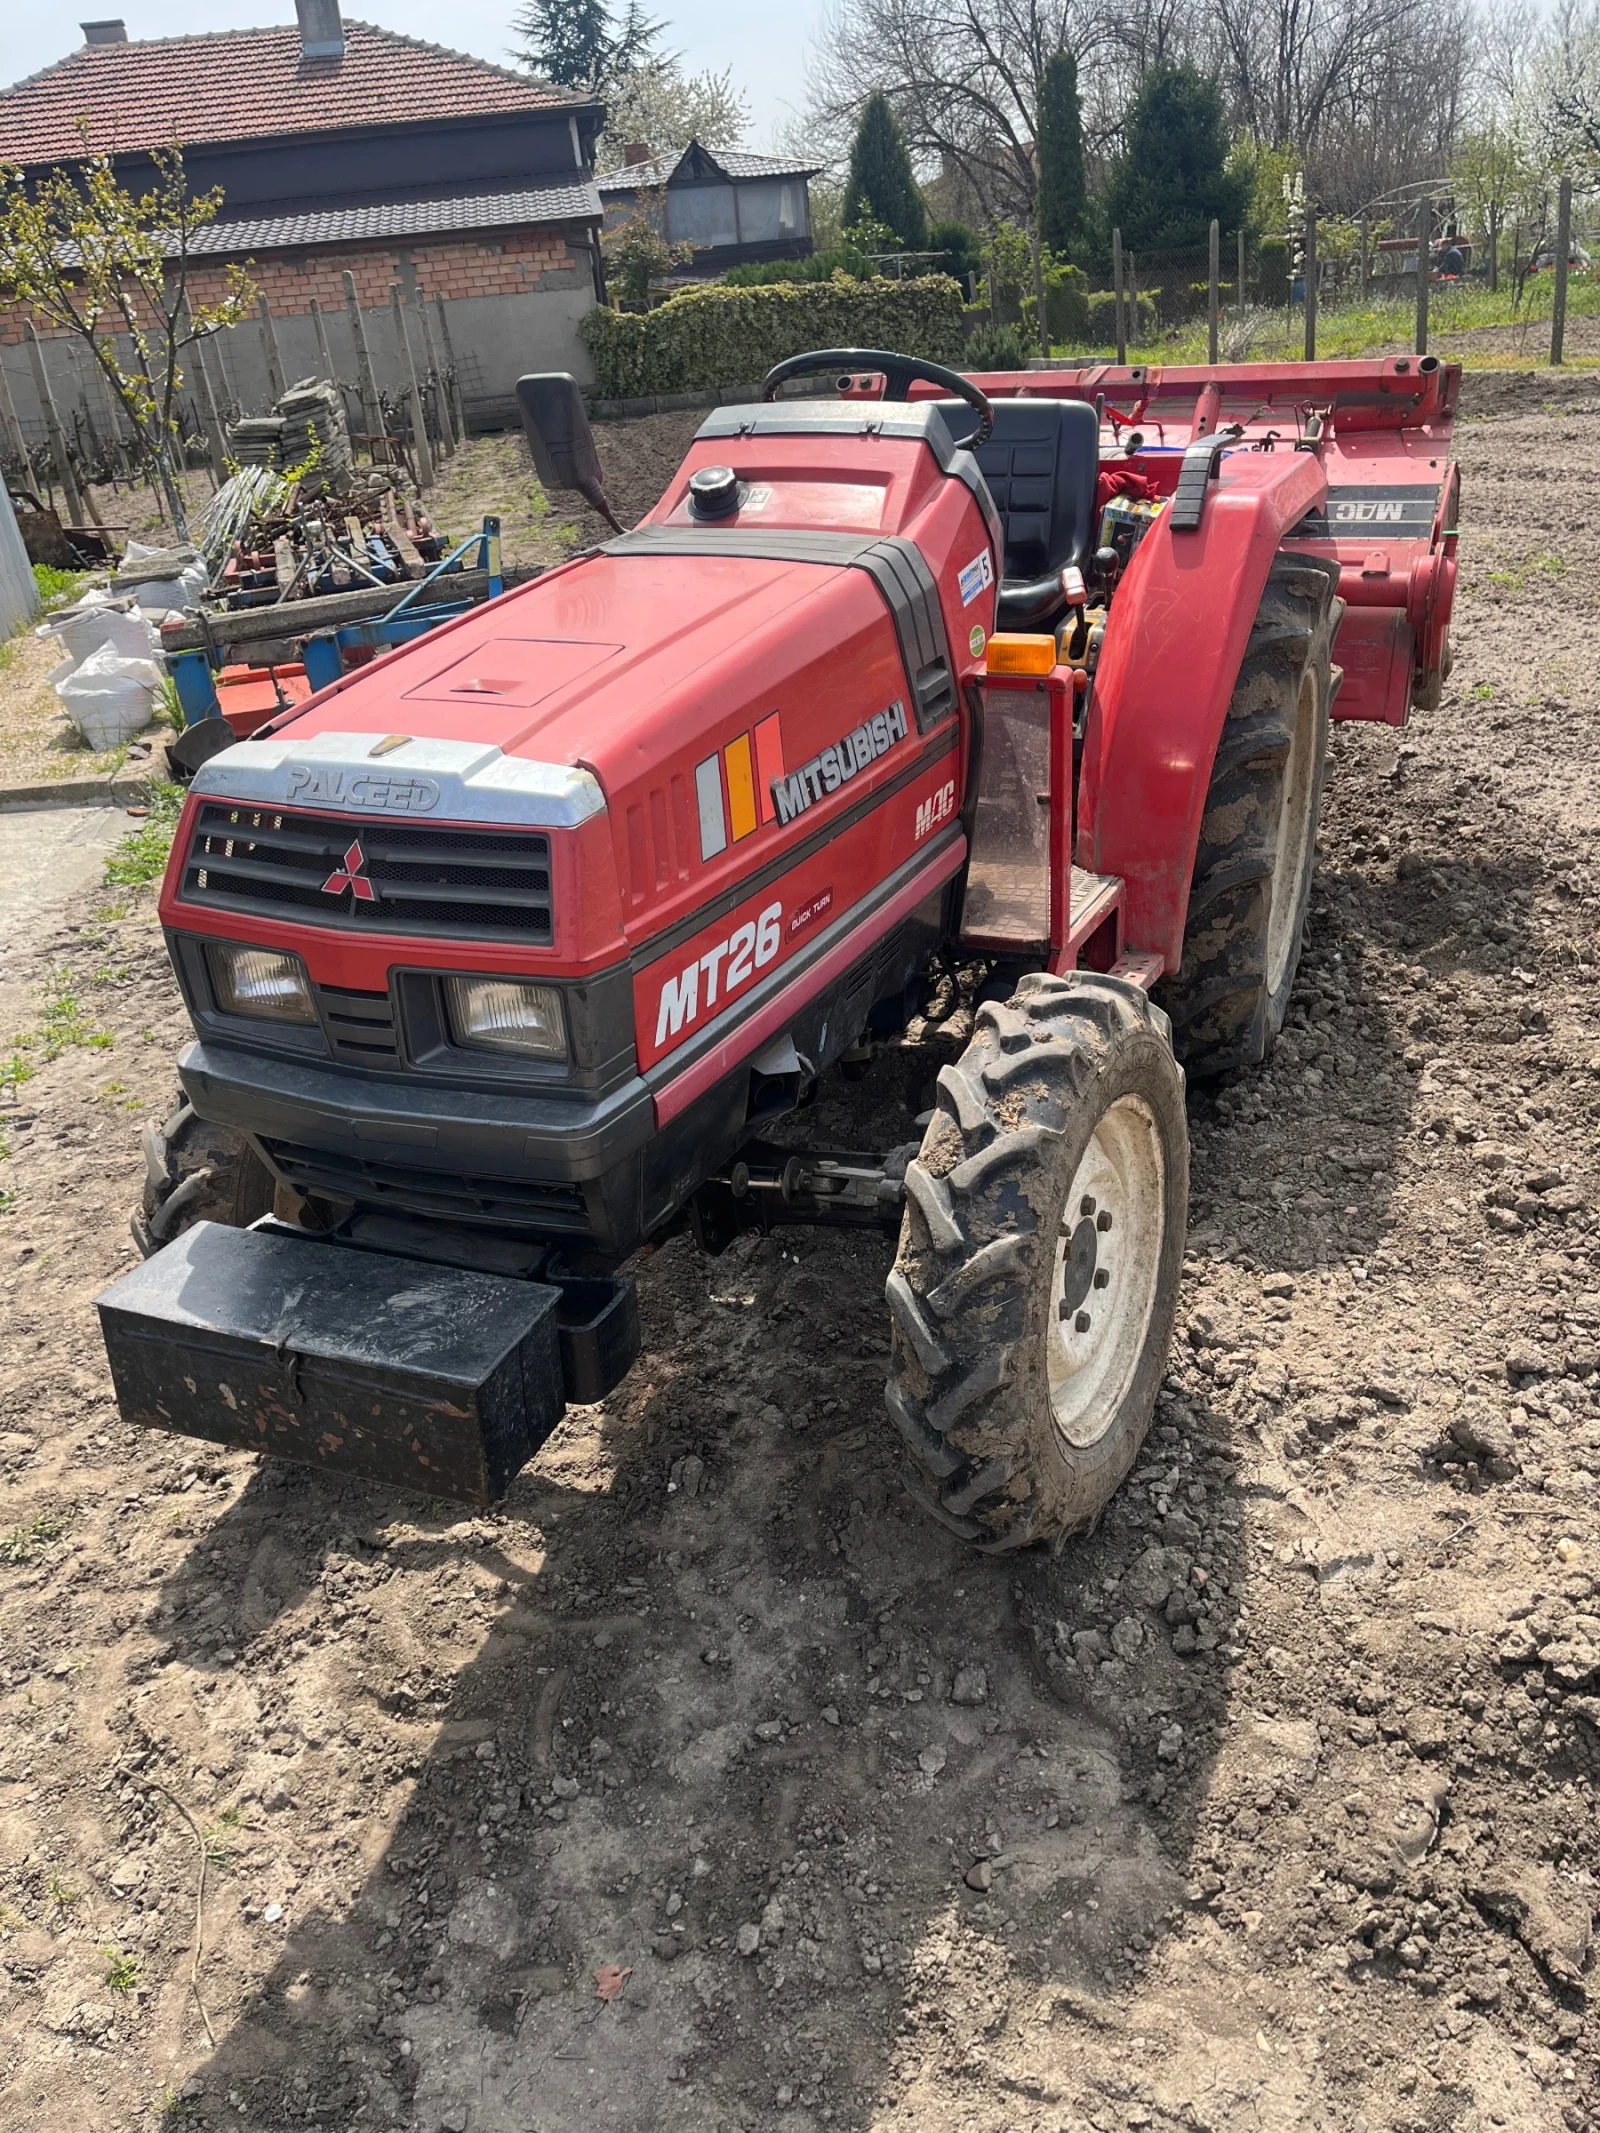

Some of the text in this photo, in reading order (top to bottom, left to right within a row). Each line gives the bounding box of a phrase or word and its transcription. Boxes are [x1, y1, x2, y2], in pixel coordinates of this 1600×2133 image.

[1336, 503, 1403, 520] MAC
[981, 555, 990, 580] 5
[771, 700, 908, 827] MITSUBISHI
[287, 765, 440, 811] PALCEED
[915, 779, 955, 841] MAC
[791, 893, 831, 931] QUICK TURN
[655, 902, 782, 1048] MT26
